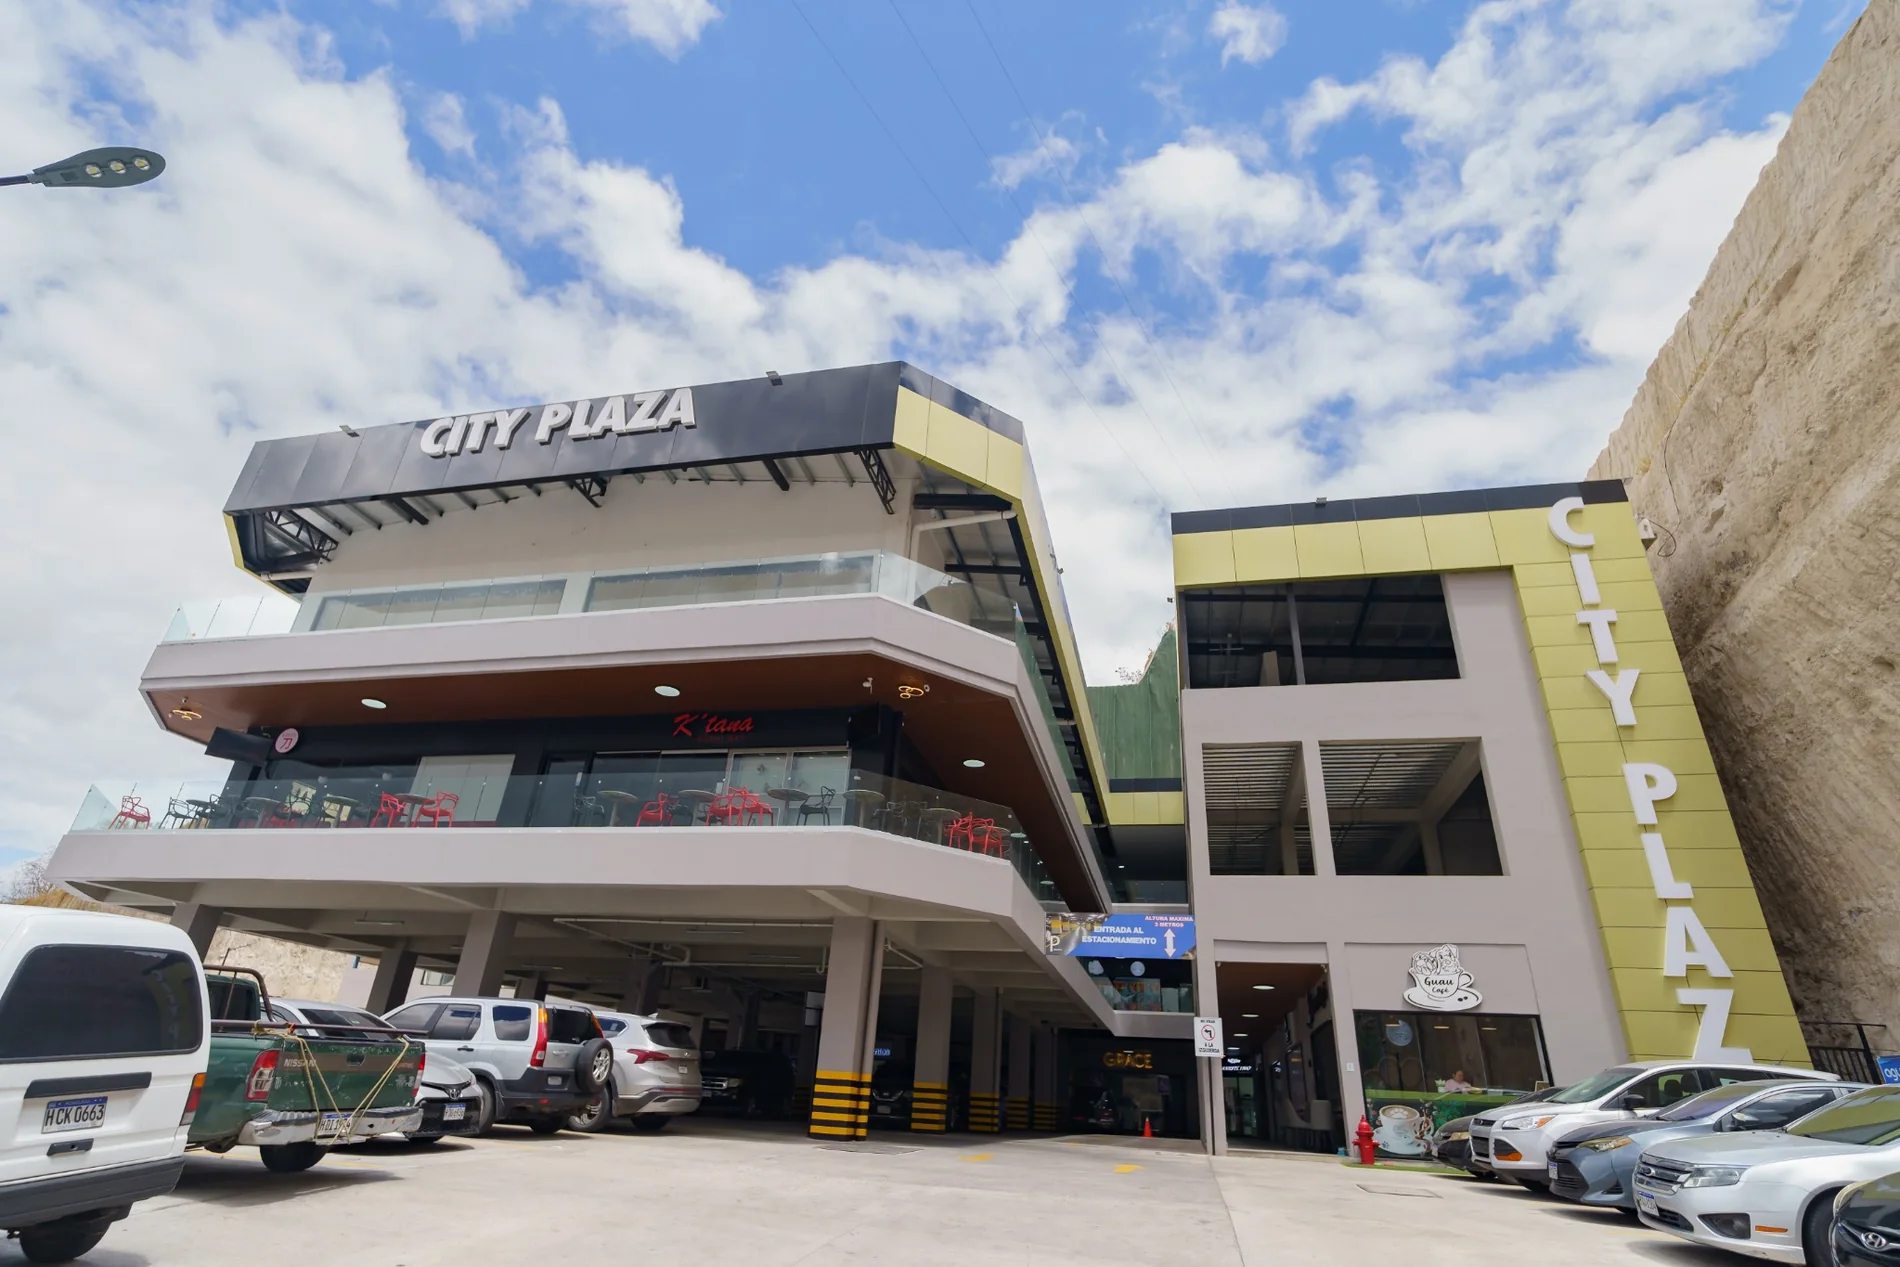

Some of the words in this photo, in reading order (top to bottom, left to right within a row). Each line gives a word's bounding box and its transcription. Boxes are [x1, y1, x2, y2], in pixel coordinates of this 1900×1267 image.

[420, 408, 530, 457] CITY
[535, 388, 696, 444] PLAZA
[672, 713, 755, 736] K'tana
[1548, 497, 1640, 726] CITY
[1622, 763, 1754, 1063] PLAZ
[1094, 926, 1132, 934] ENTRADA
[1082, 936, 1157, 945] ESTACIONAMIENTO
[1424, 977, 1454, 986] Guau
[1103, 1052, 1152, 1068] GRACE
[74, 1105, 104, 1123] 0663
